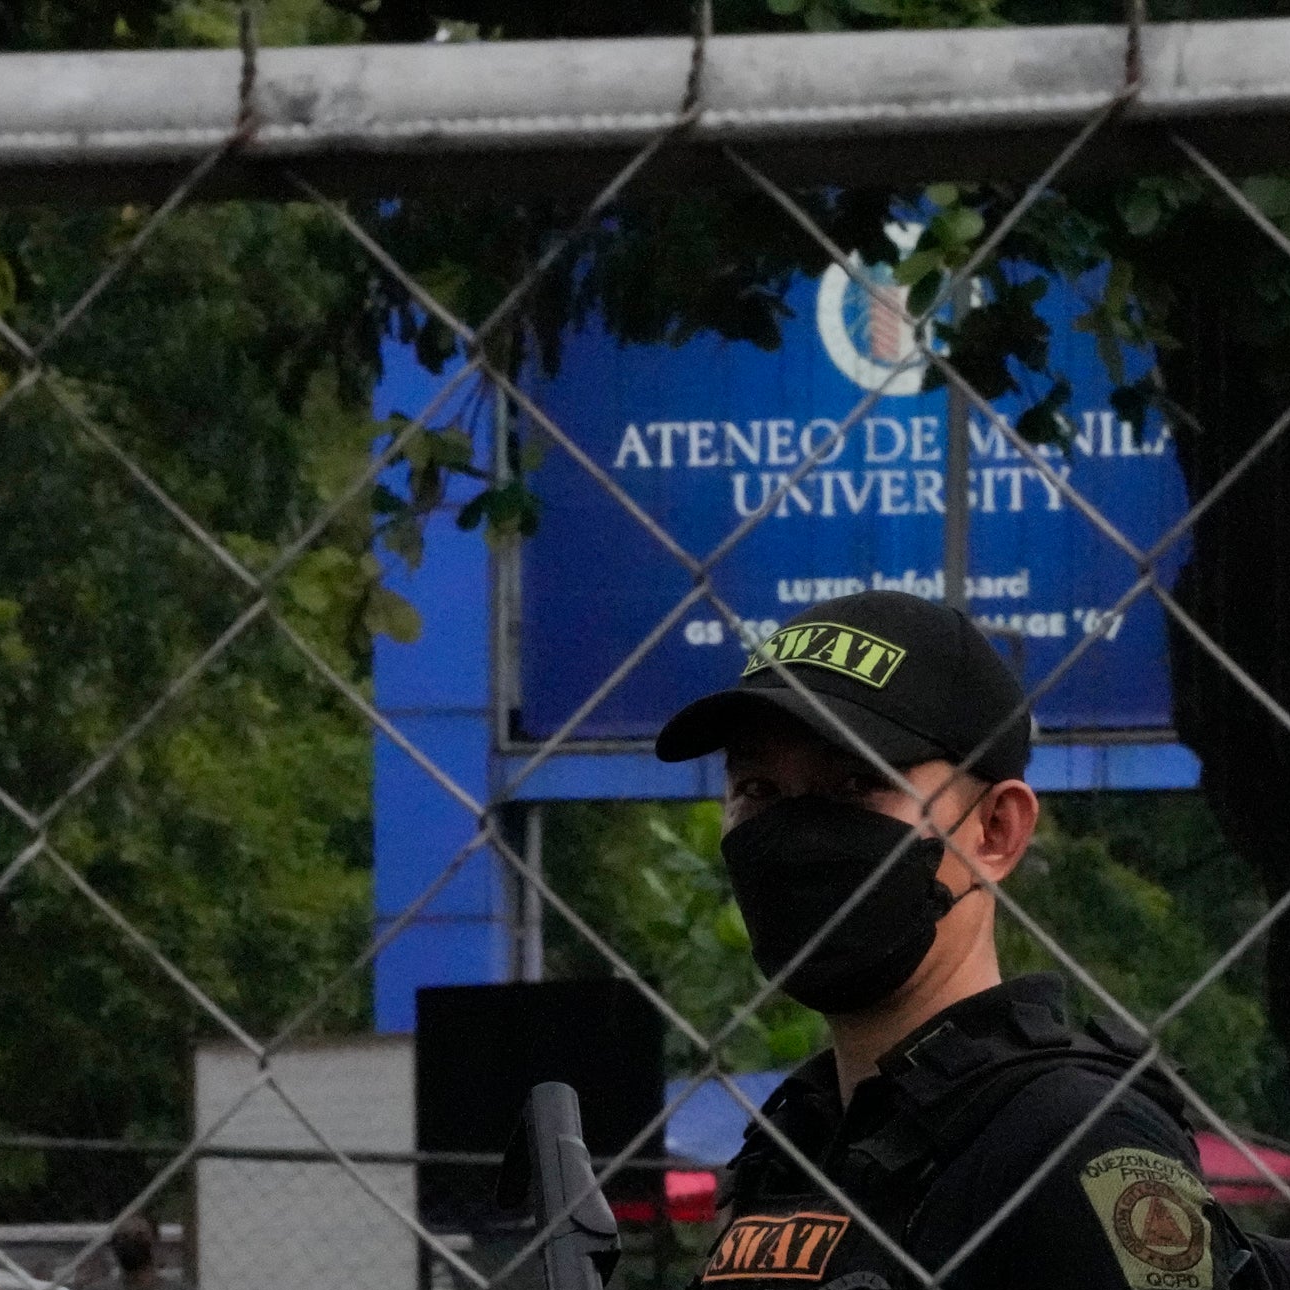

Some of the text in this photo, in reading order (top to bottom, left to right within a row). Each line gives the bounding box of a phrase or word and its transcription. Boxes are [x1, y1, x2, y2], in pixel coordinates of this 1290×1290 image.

[614, 410, 1173, 468] ATENEO DE MNIL
[751, 627, 897, 679] SWAT
[1084, 1154, 1150, 1179] QUEZON
[1120, 1167, 1176, 1184] PRIDE
[710, 1222, 838, 1271] SWAT
[1145, 1271, 1200, 1289] QCPD
